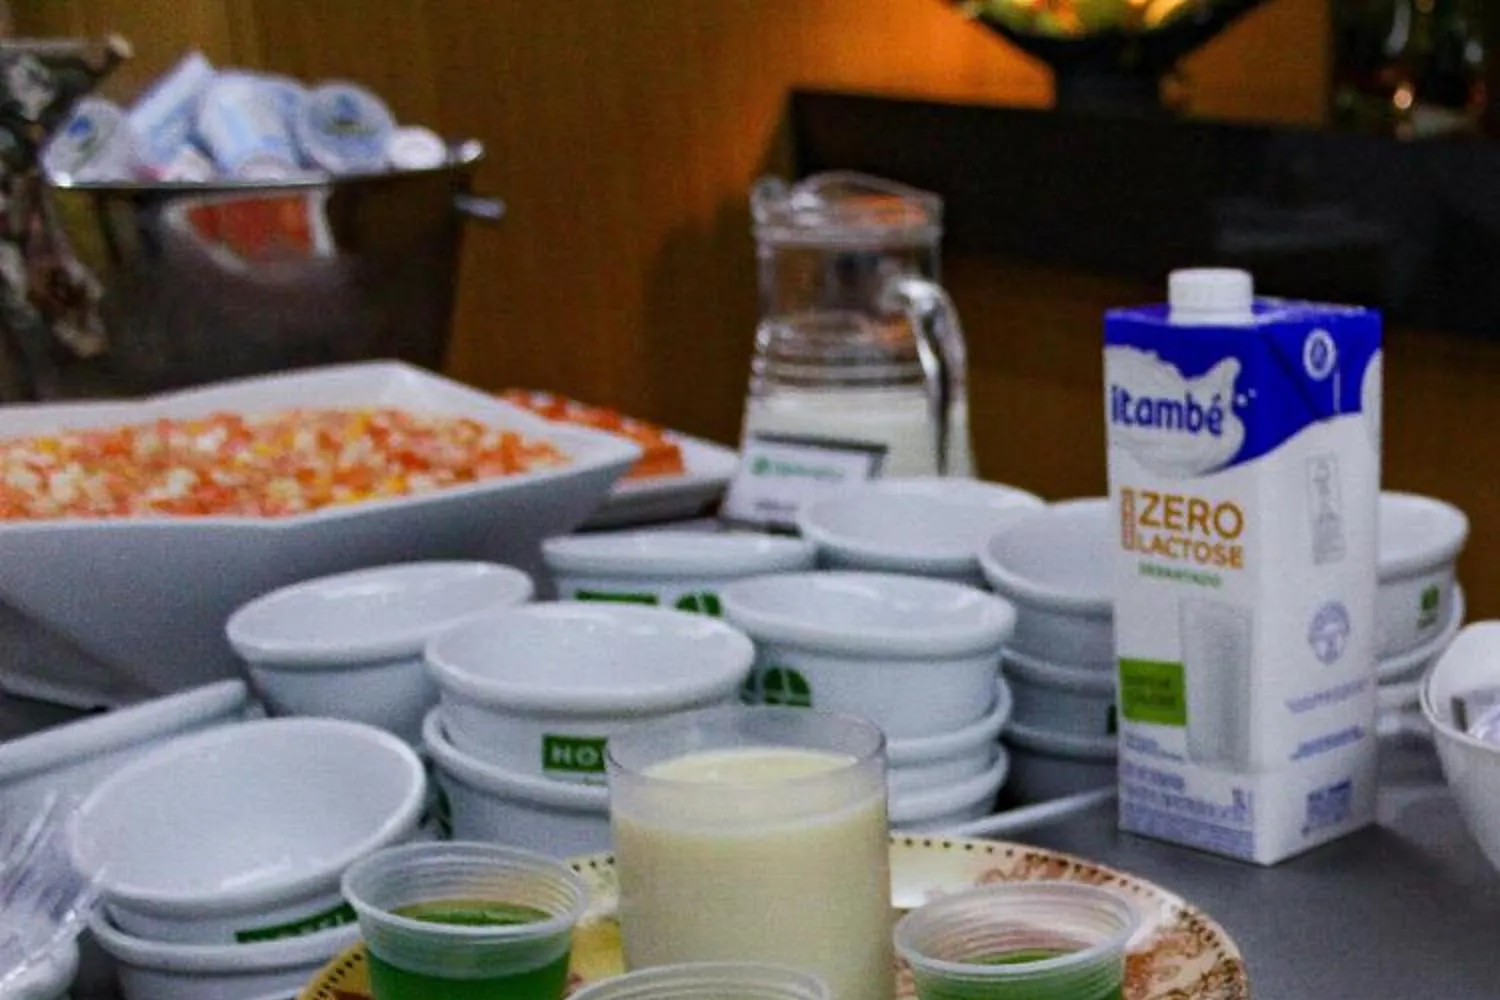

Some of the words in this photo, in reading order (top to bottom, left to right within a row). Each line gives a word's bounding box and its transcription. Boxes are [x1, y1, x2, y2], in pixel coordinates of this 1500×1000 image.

[1112, 385, 1223, 436] itambé
[1139, 489, 1244, 540] ZERO
[1134, 533, 1244, 569] LACTOSE
